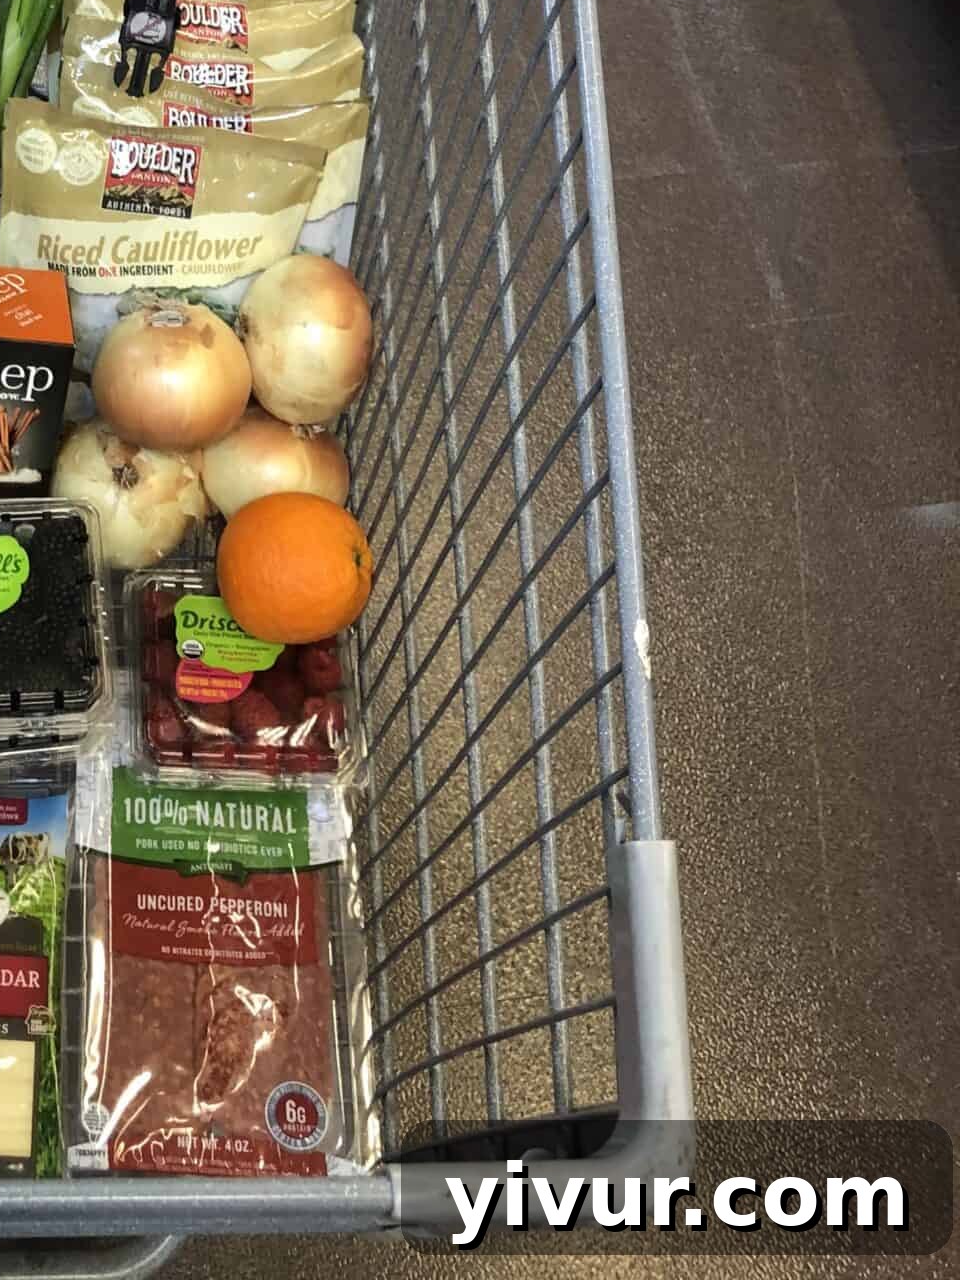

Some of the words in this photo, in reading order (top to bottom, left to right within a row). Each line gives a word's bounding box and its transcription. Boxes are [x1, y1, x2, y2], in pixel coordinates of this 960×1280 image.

[181, 5, 245, 34] OULDER
[111, 139, 196, 184] BOULDER
[106, 202, 156, 215] AUTHENTIC
[37, 234, 106, 265] Riced
[111, 230, 263, 264] Cauliflower
[72, 264, 97, 277] FROM
[119, 265, 173, 277] INGREDIENT
[181, 610, 244, 632] Drisc
[123, 797, 188, 826] 100%
[196, 800, 296, 834] NATURAL
[136, 837, 158, 849] PORK
[162, 839, 185, 850] USED
[188, 840, 200, 851] NO
[260, 846, 282, 857] EVER
[136, 894, 204, 912] UNCURED
[210, 897, 288, 917] PEPPERONI
[123, 912, 173, 932] Natural
[285, 1100, 307, 1123] 6G
